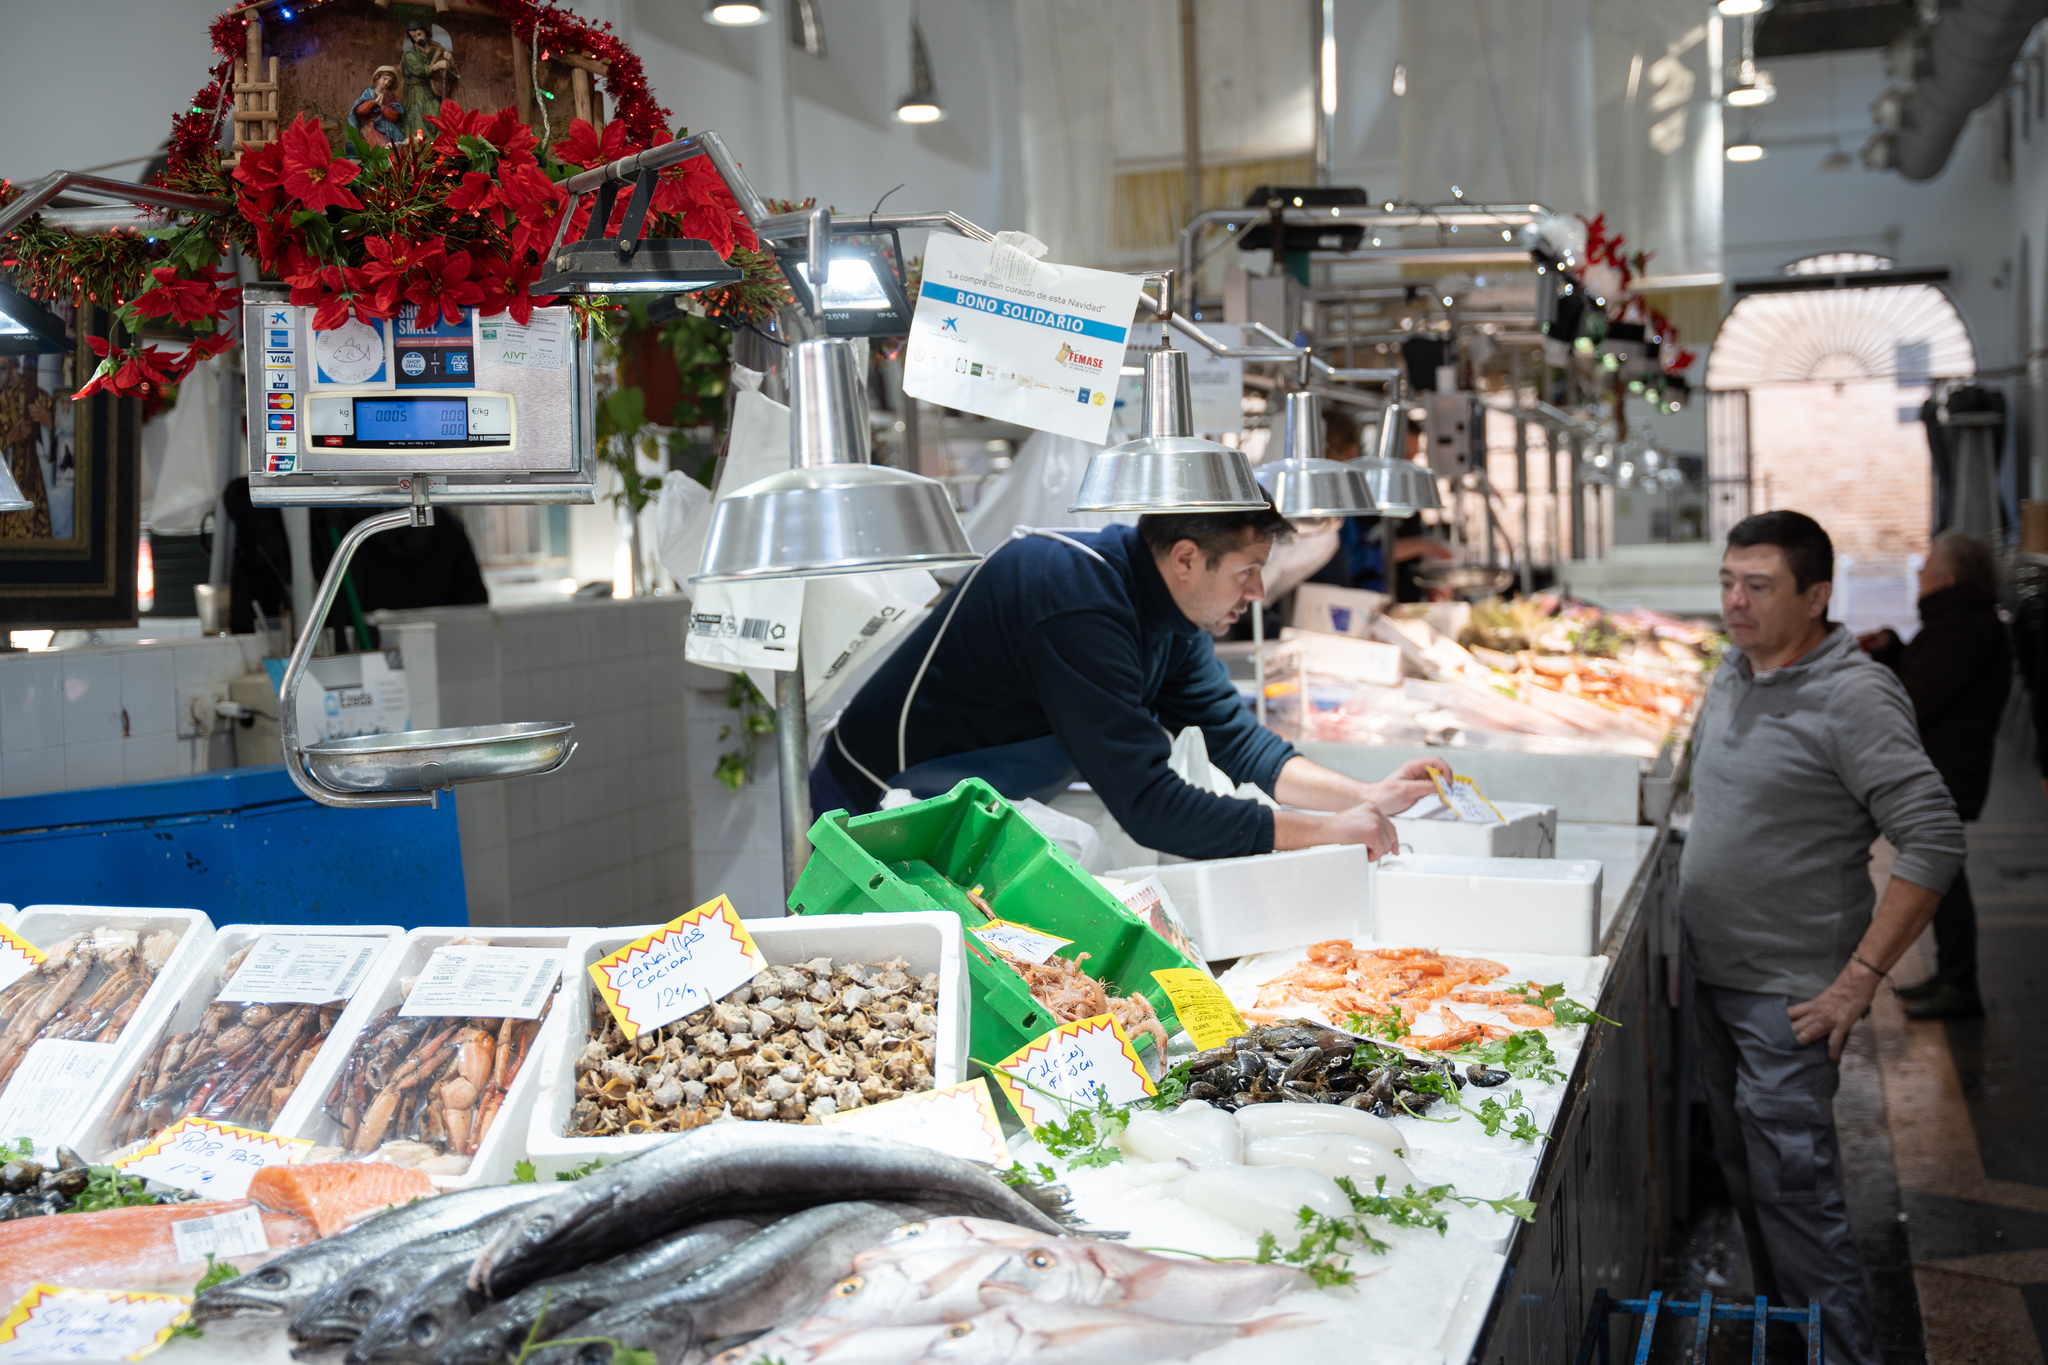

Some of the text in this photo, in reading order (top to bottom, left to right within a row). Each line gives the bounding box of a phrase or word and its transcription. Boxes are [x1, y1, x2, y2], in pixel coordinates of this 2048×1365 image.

[959, 274, 987, 288] compra
[988, 280, 1003, 290] con
[1005, 284, 1035, 297] corazón
[1037, 290, 1046, 300] de
[1048, 295, 1066, 304] esta
[956, 292, 1084, 332] BONO SOLIDARIO
[353, 322, 378, 344] MEJOR
[270, 356, 291, 364] VISA
[502, 351, 528, 360] AIVT
[1069, 352, 1104, 368] FEMASE
[340, 409, 349, 417] kg
[472, 408, 489, 416] €/kg
[1195, 1014, 1225, 1022] GOURMET
